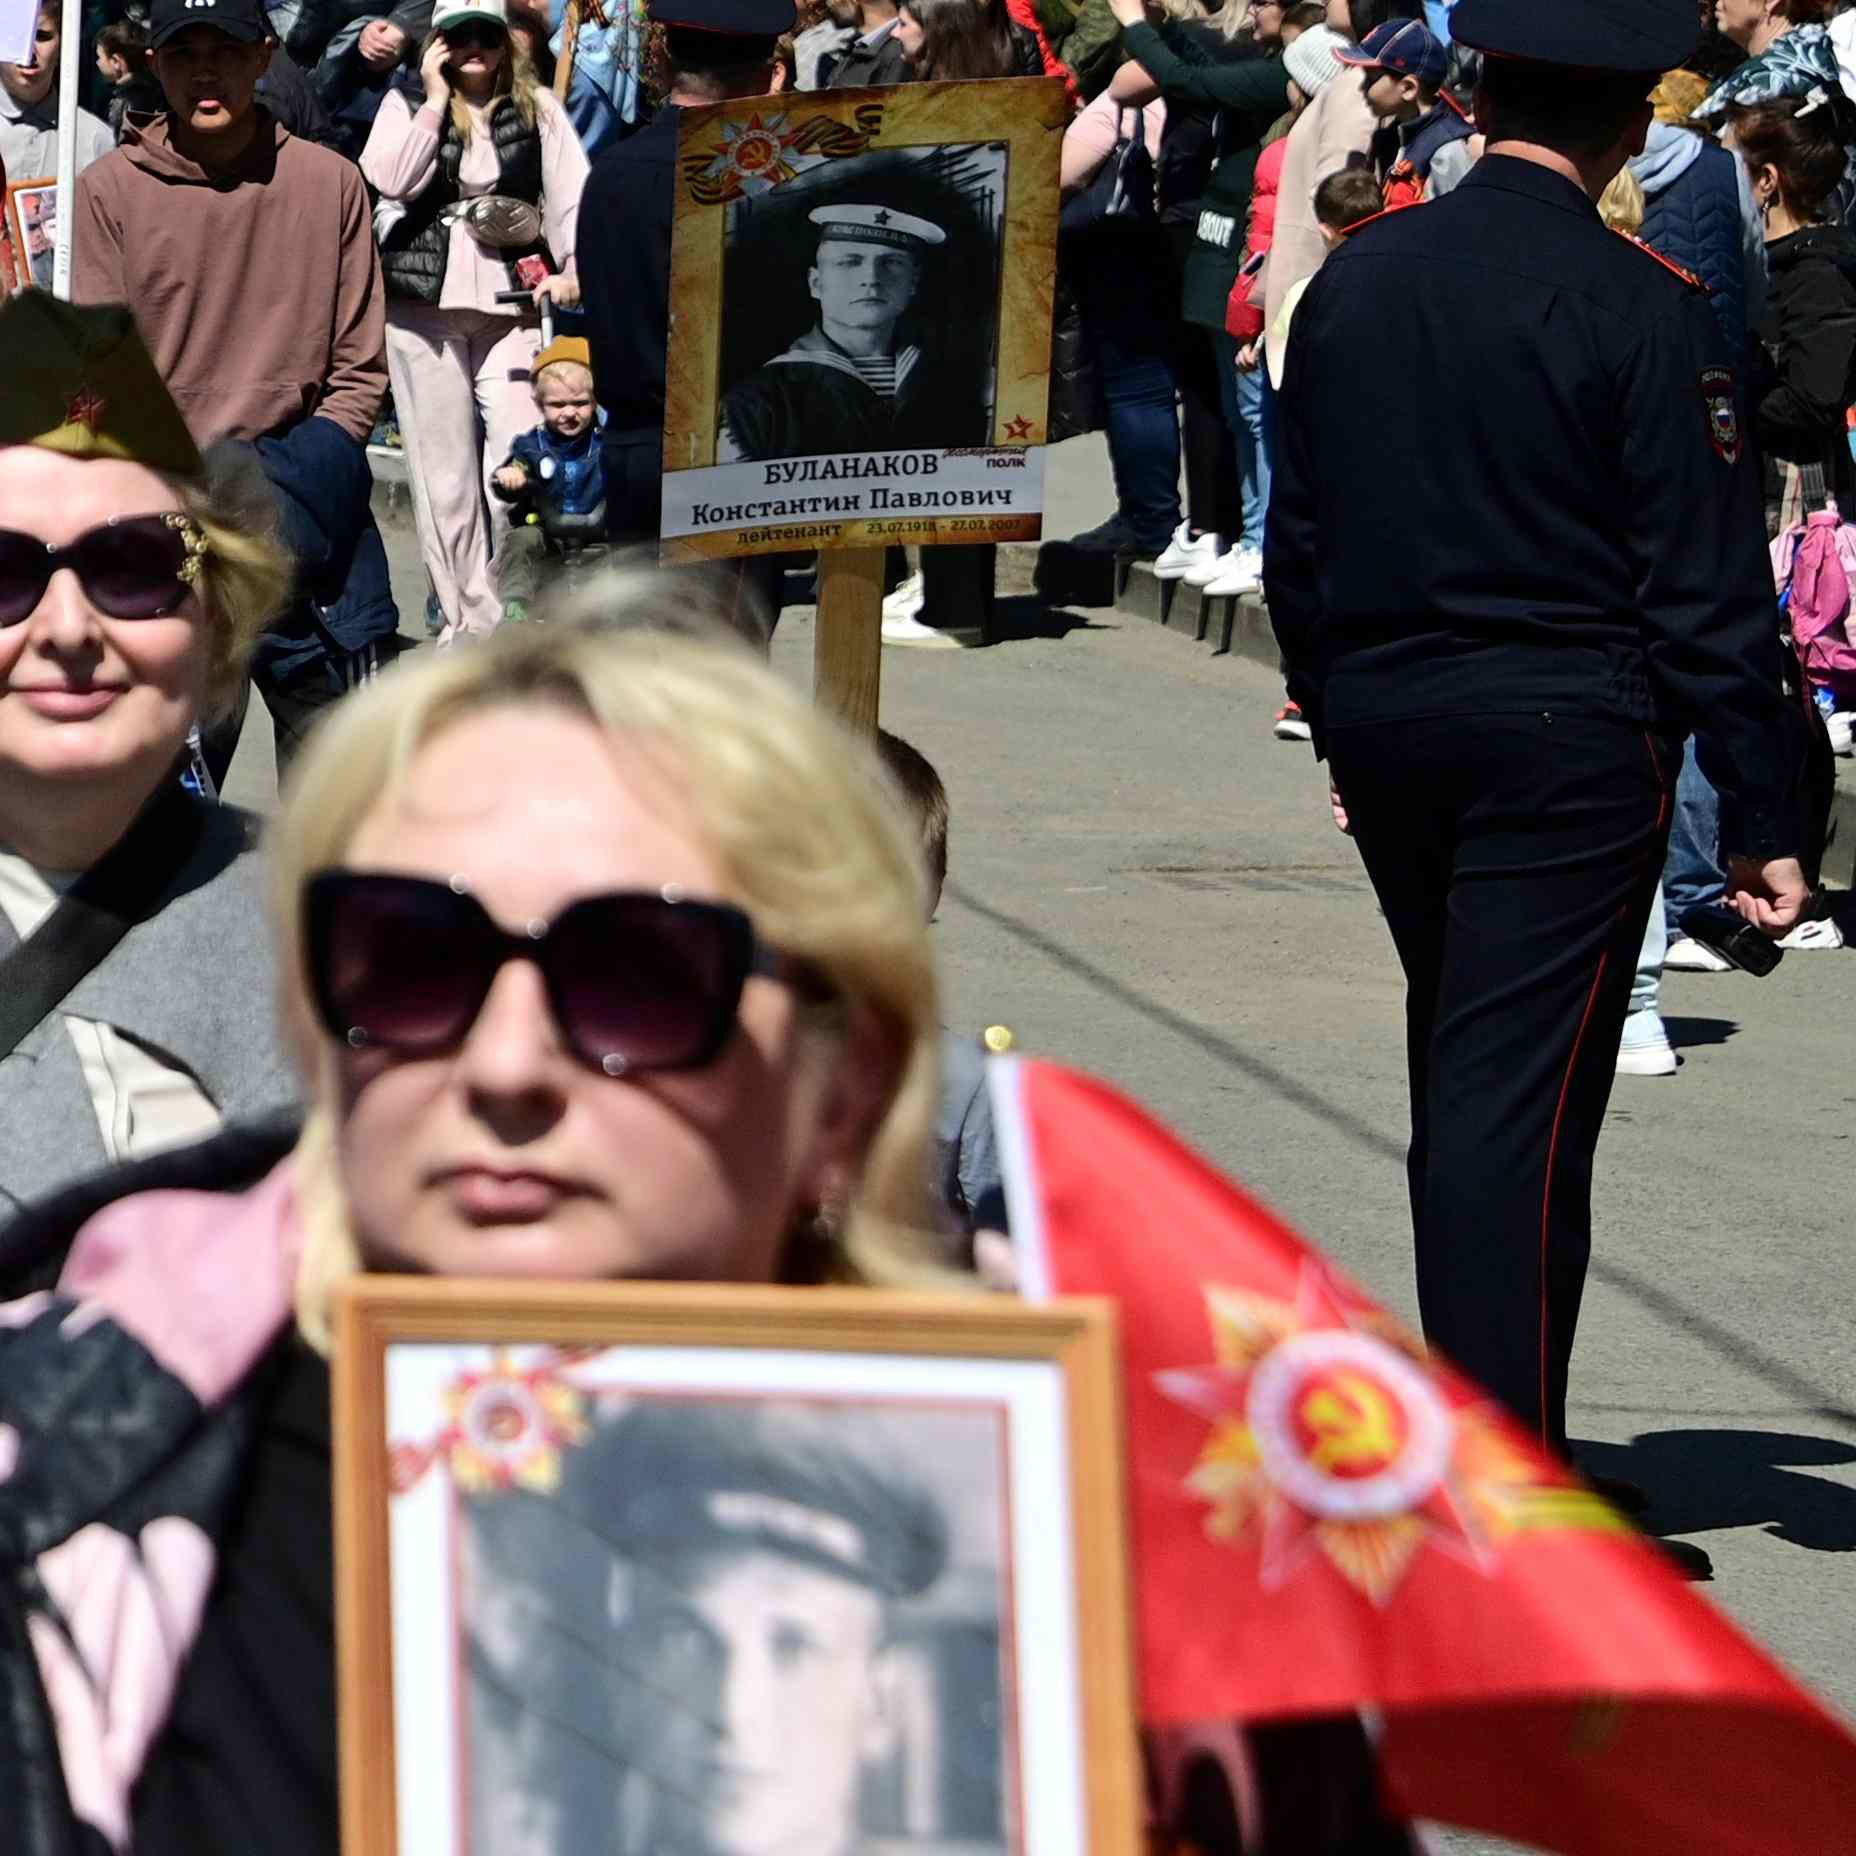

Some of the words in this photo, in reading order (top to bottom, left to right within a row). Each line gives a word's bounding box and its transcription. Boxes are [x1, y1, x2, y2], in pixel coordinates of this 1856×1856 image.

[763, 453, 938, 486] БУЛАНАКОВ
[986, 457, 1026, 469] ПОЛК
[691, 493, 861, 526] Константин
[868, 487, 1013, 510] Павлович
[737, 522, 841, 545] лейтенант
